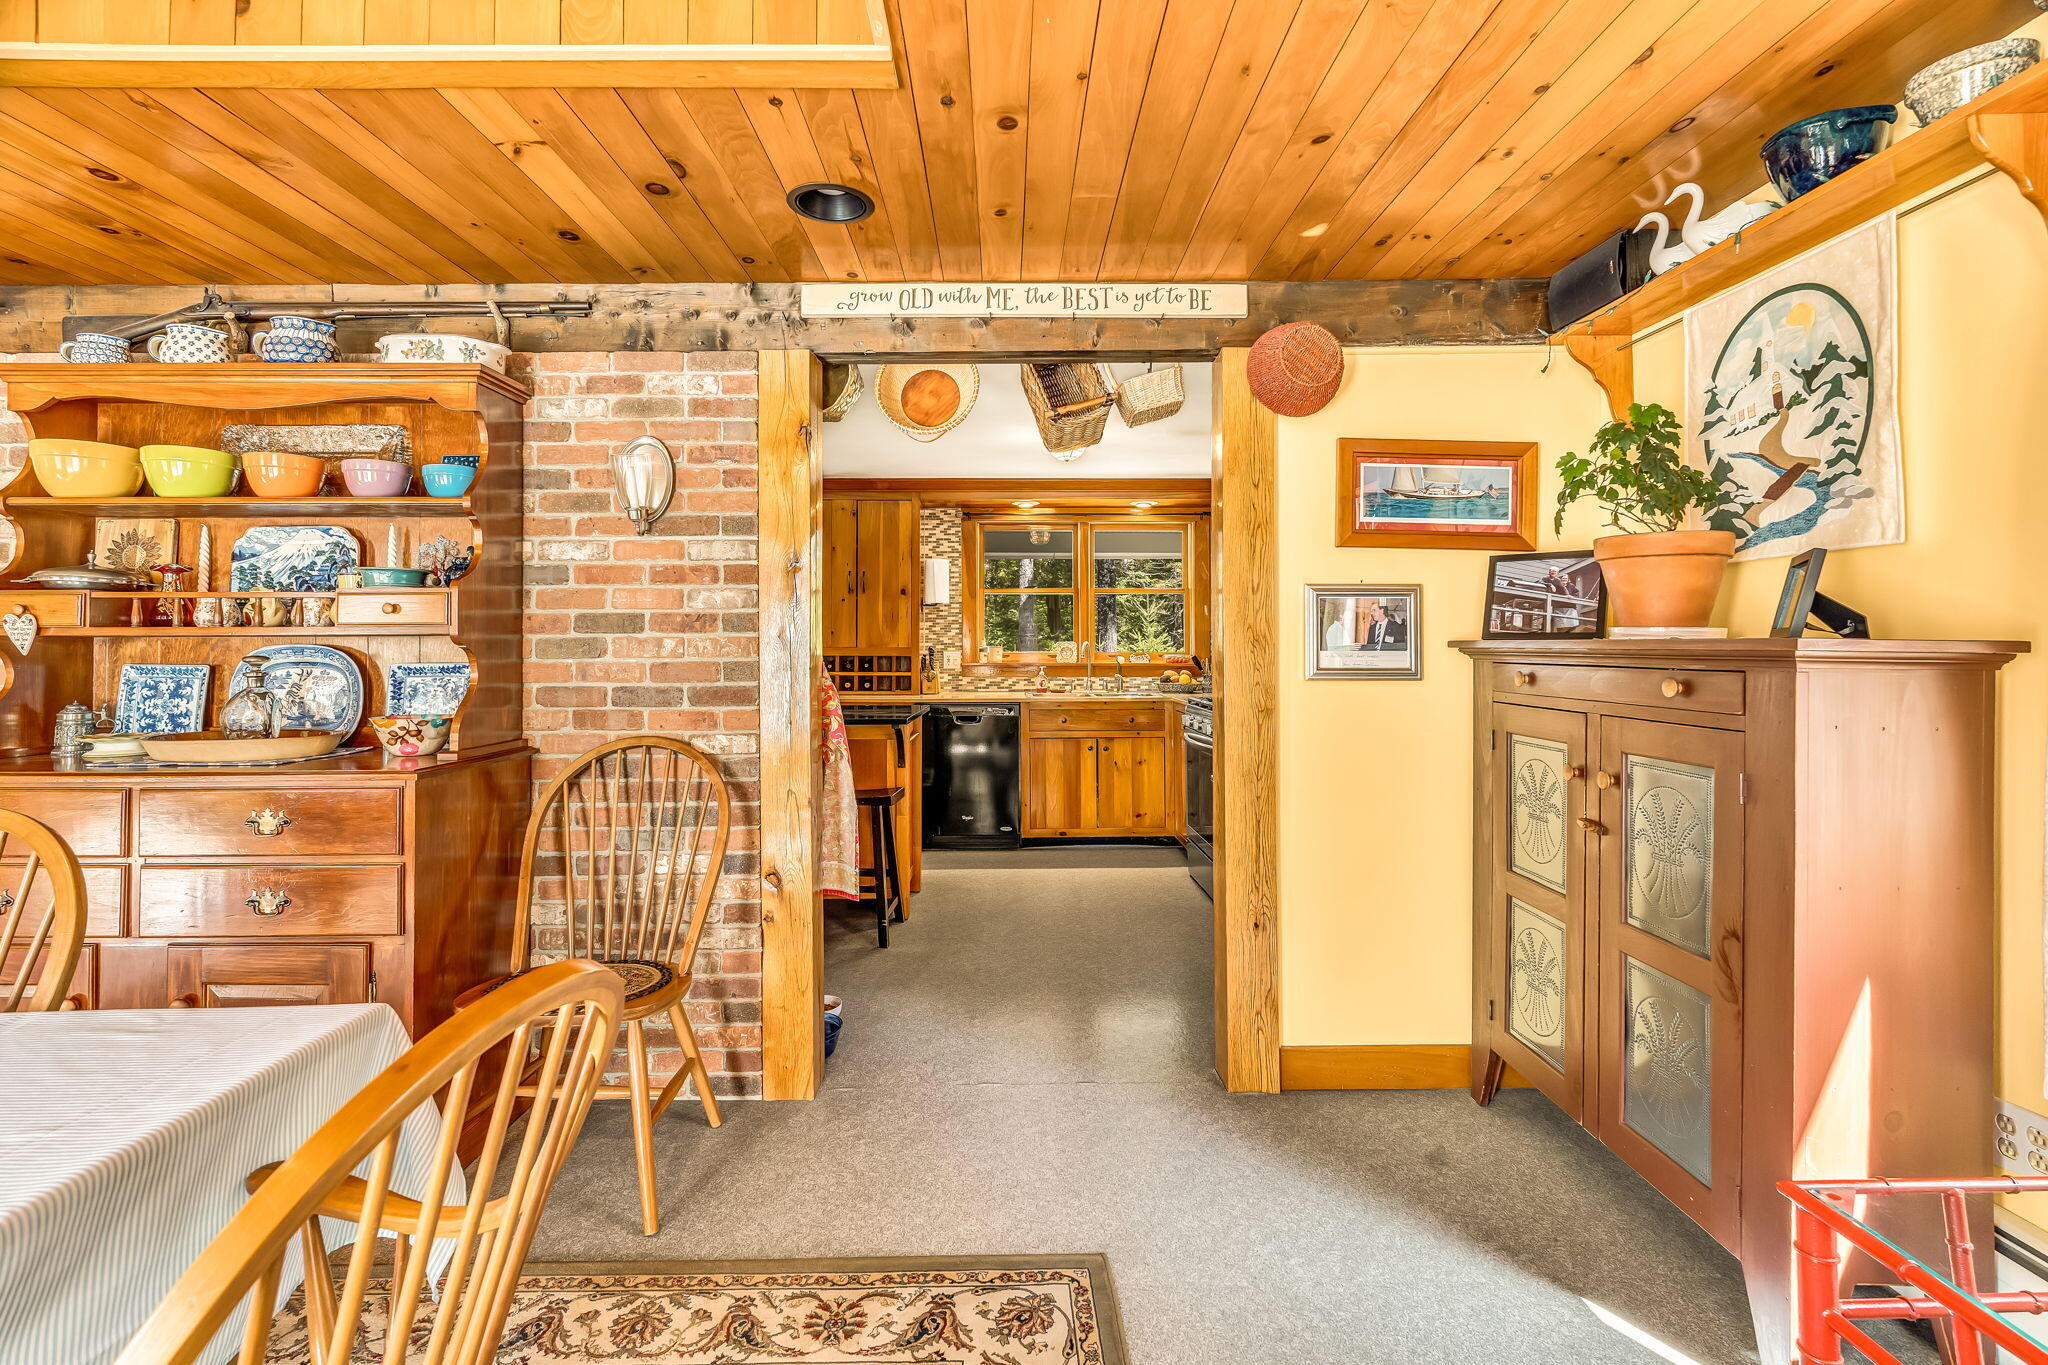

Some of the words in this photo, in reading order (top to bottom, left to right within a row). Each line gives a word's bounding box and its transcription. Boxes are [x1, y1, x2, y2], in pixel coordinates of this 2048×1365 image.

[837, 289, 892, 310] grow
[899, 287, 933, 310] OLD
[938, 286, 982, 304] with
[986, 286, 1019, 311] ME,
[1024, 286, 1059, 304] the
[1062, 286, 1113, 311] BEST
[1115, 290, 1129, 303] is
[1133, 287, 1164, 312] yet
[1165, 287, 1187, 304] to
[1188, 288, 1212, 311] BE
